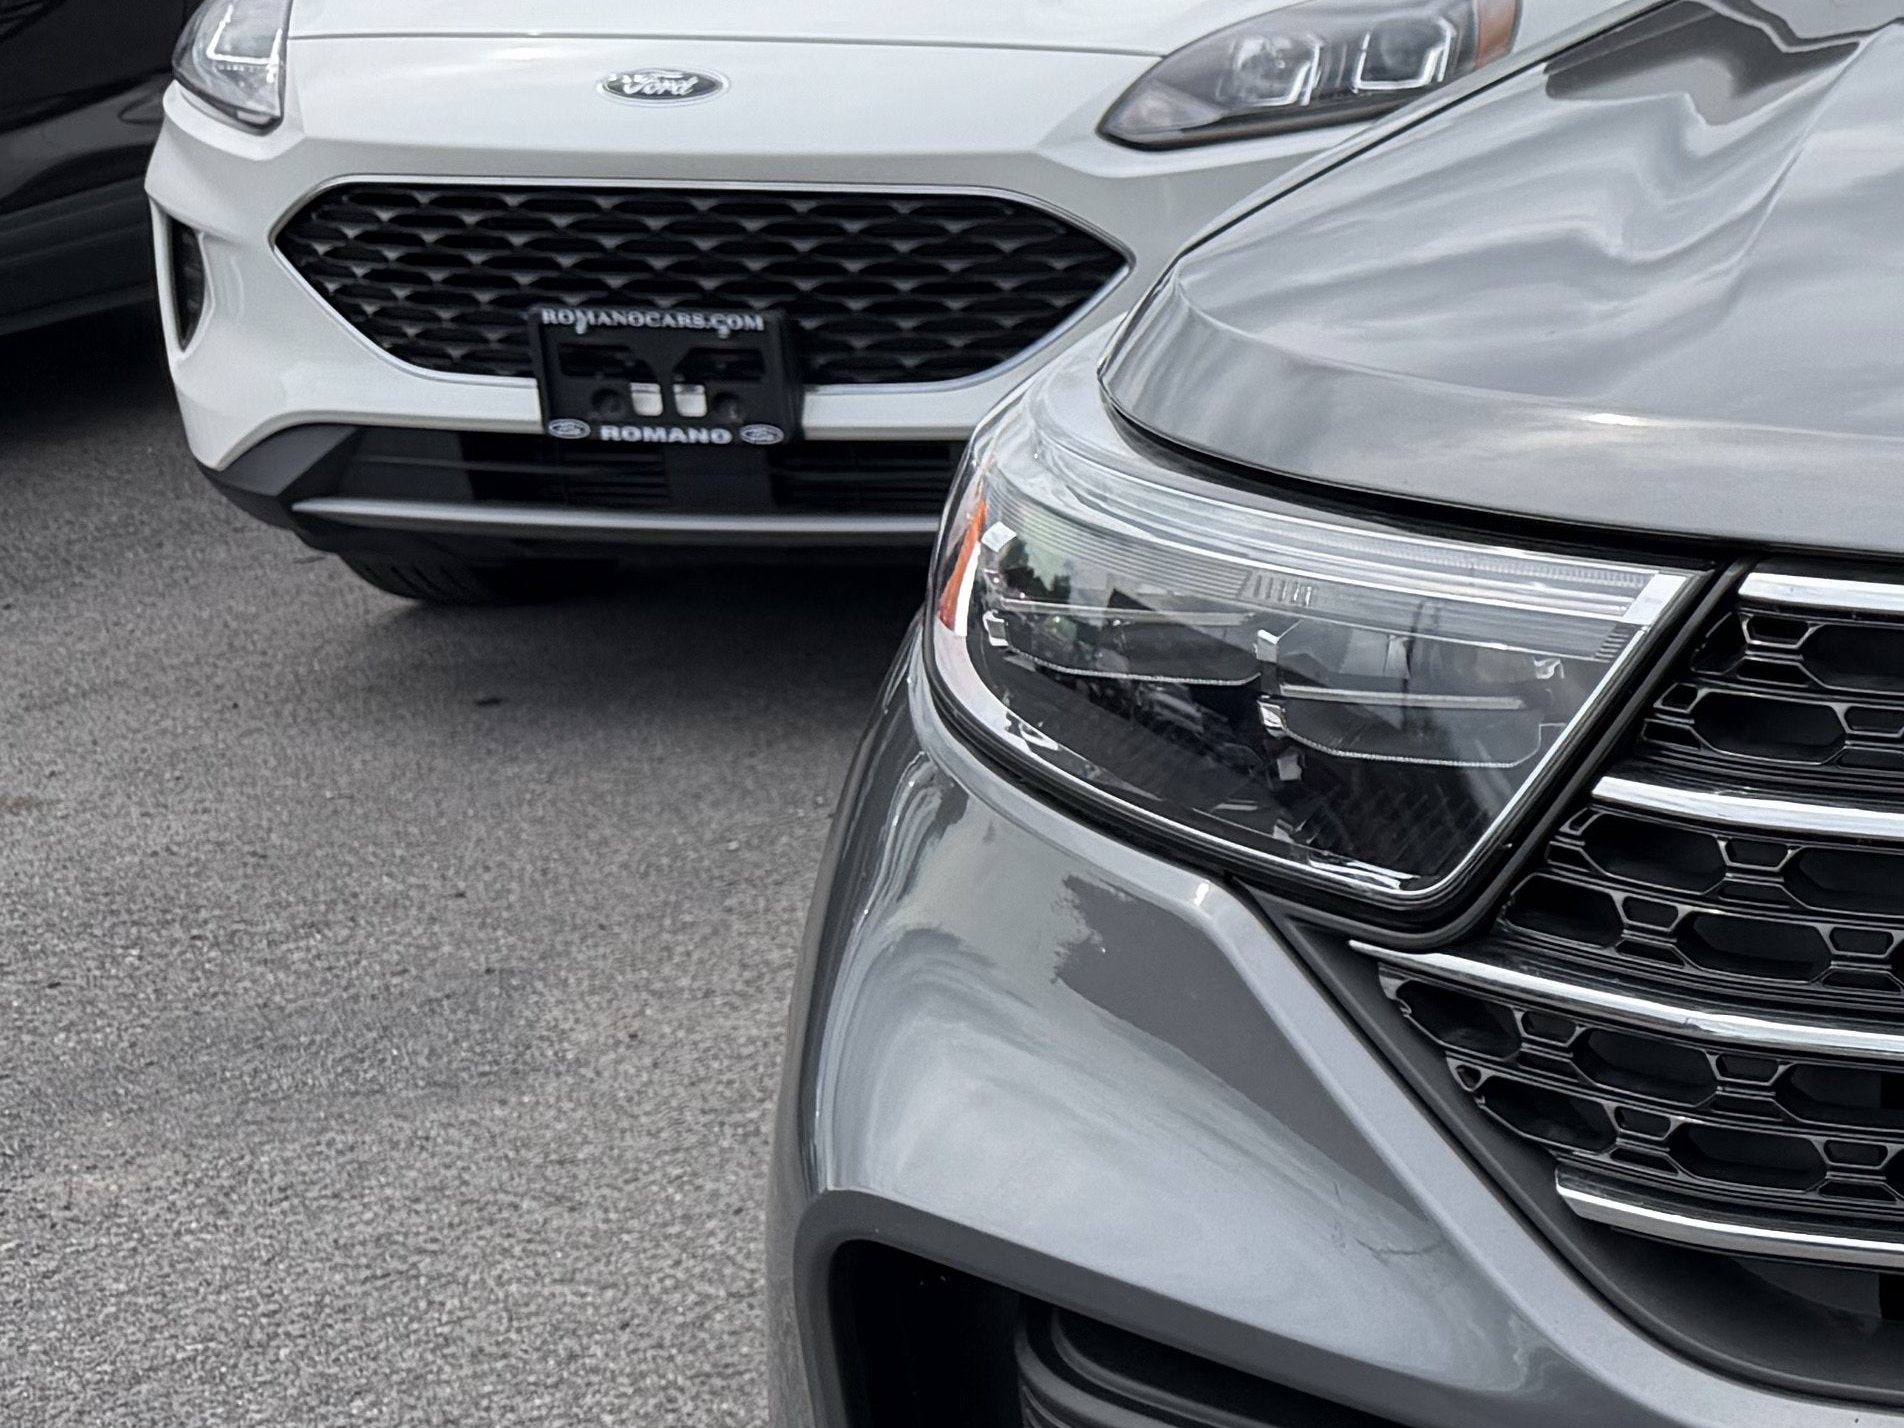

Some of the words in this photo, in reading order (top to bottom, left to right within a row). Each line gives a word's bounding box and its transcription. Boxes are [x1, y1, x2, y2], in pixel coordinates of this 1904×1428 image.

[622, 71, 699, 96] Ford
[541, 308, 765, 332] ROMANOCARS.COM
[600, 424, 733, 445] ROMANO
